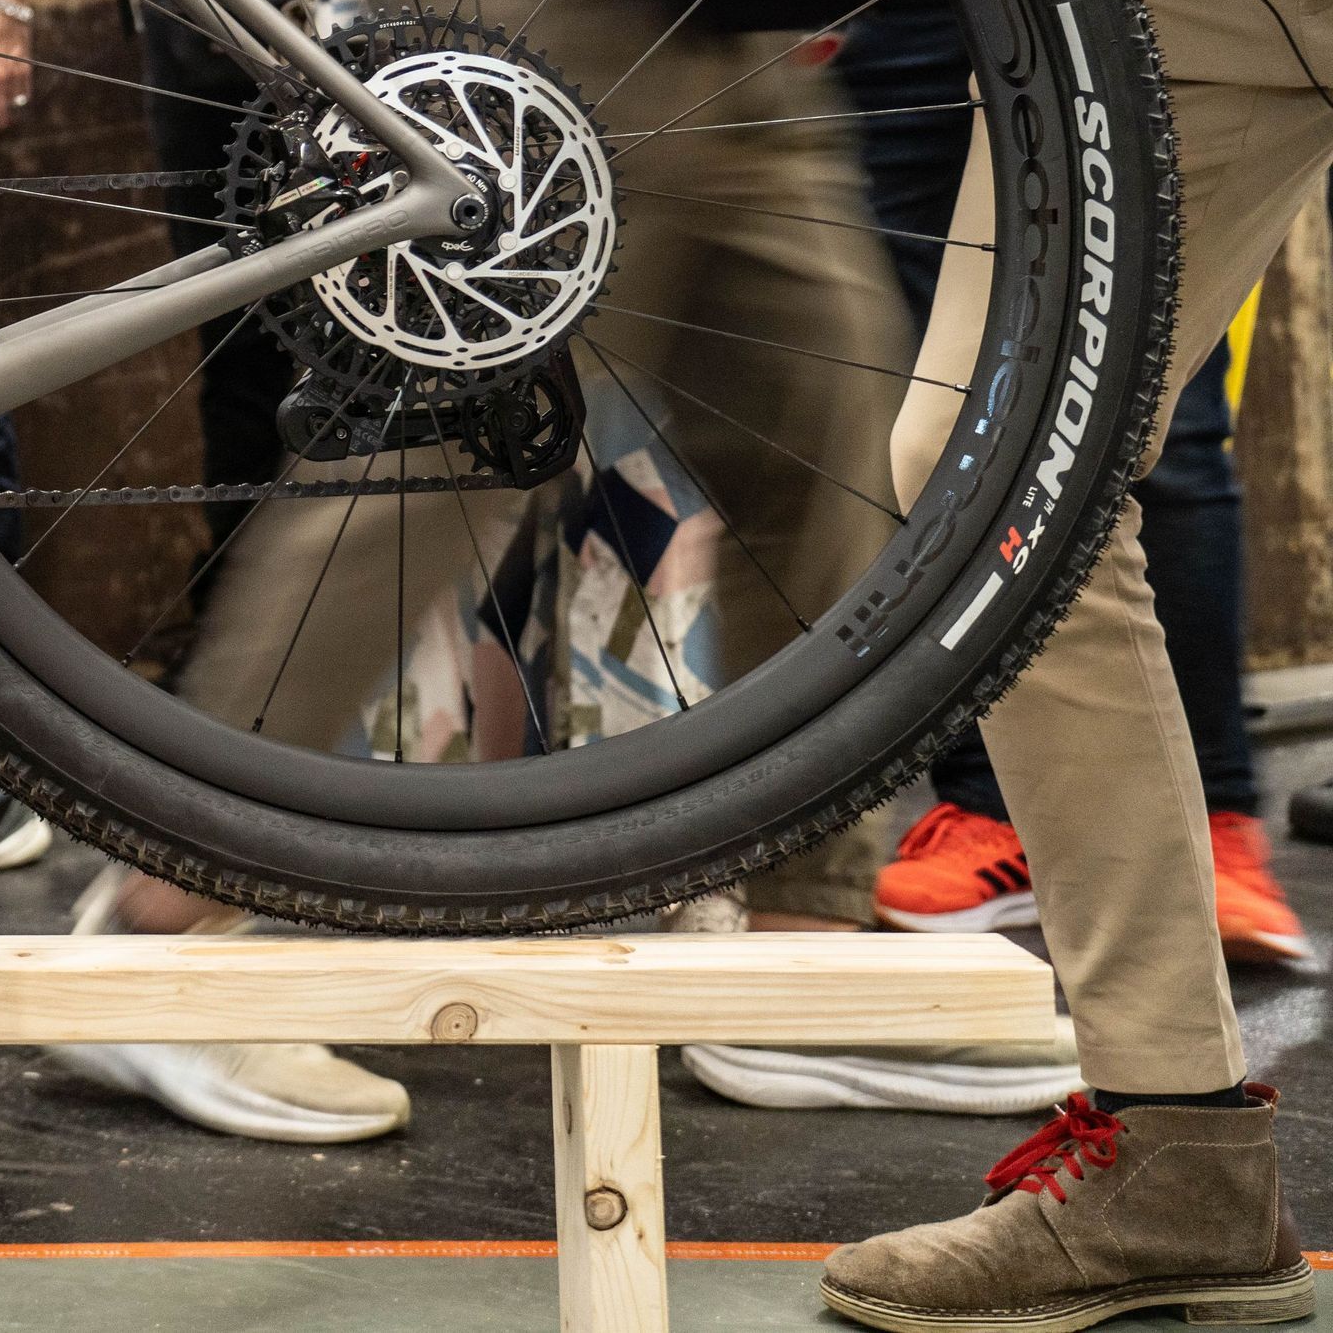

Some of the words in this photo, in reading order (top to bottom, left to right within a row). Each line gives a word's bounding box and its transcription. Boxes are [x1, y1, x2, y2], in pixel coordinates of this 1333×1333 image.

[1047, 99, 1119, 500] SCORPION
[1022, 485, 1039, 509] LITE
[998, 525, 1021, 561] H
[1012, 518, 1047, 575] XC
